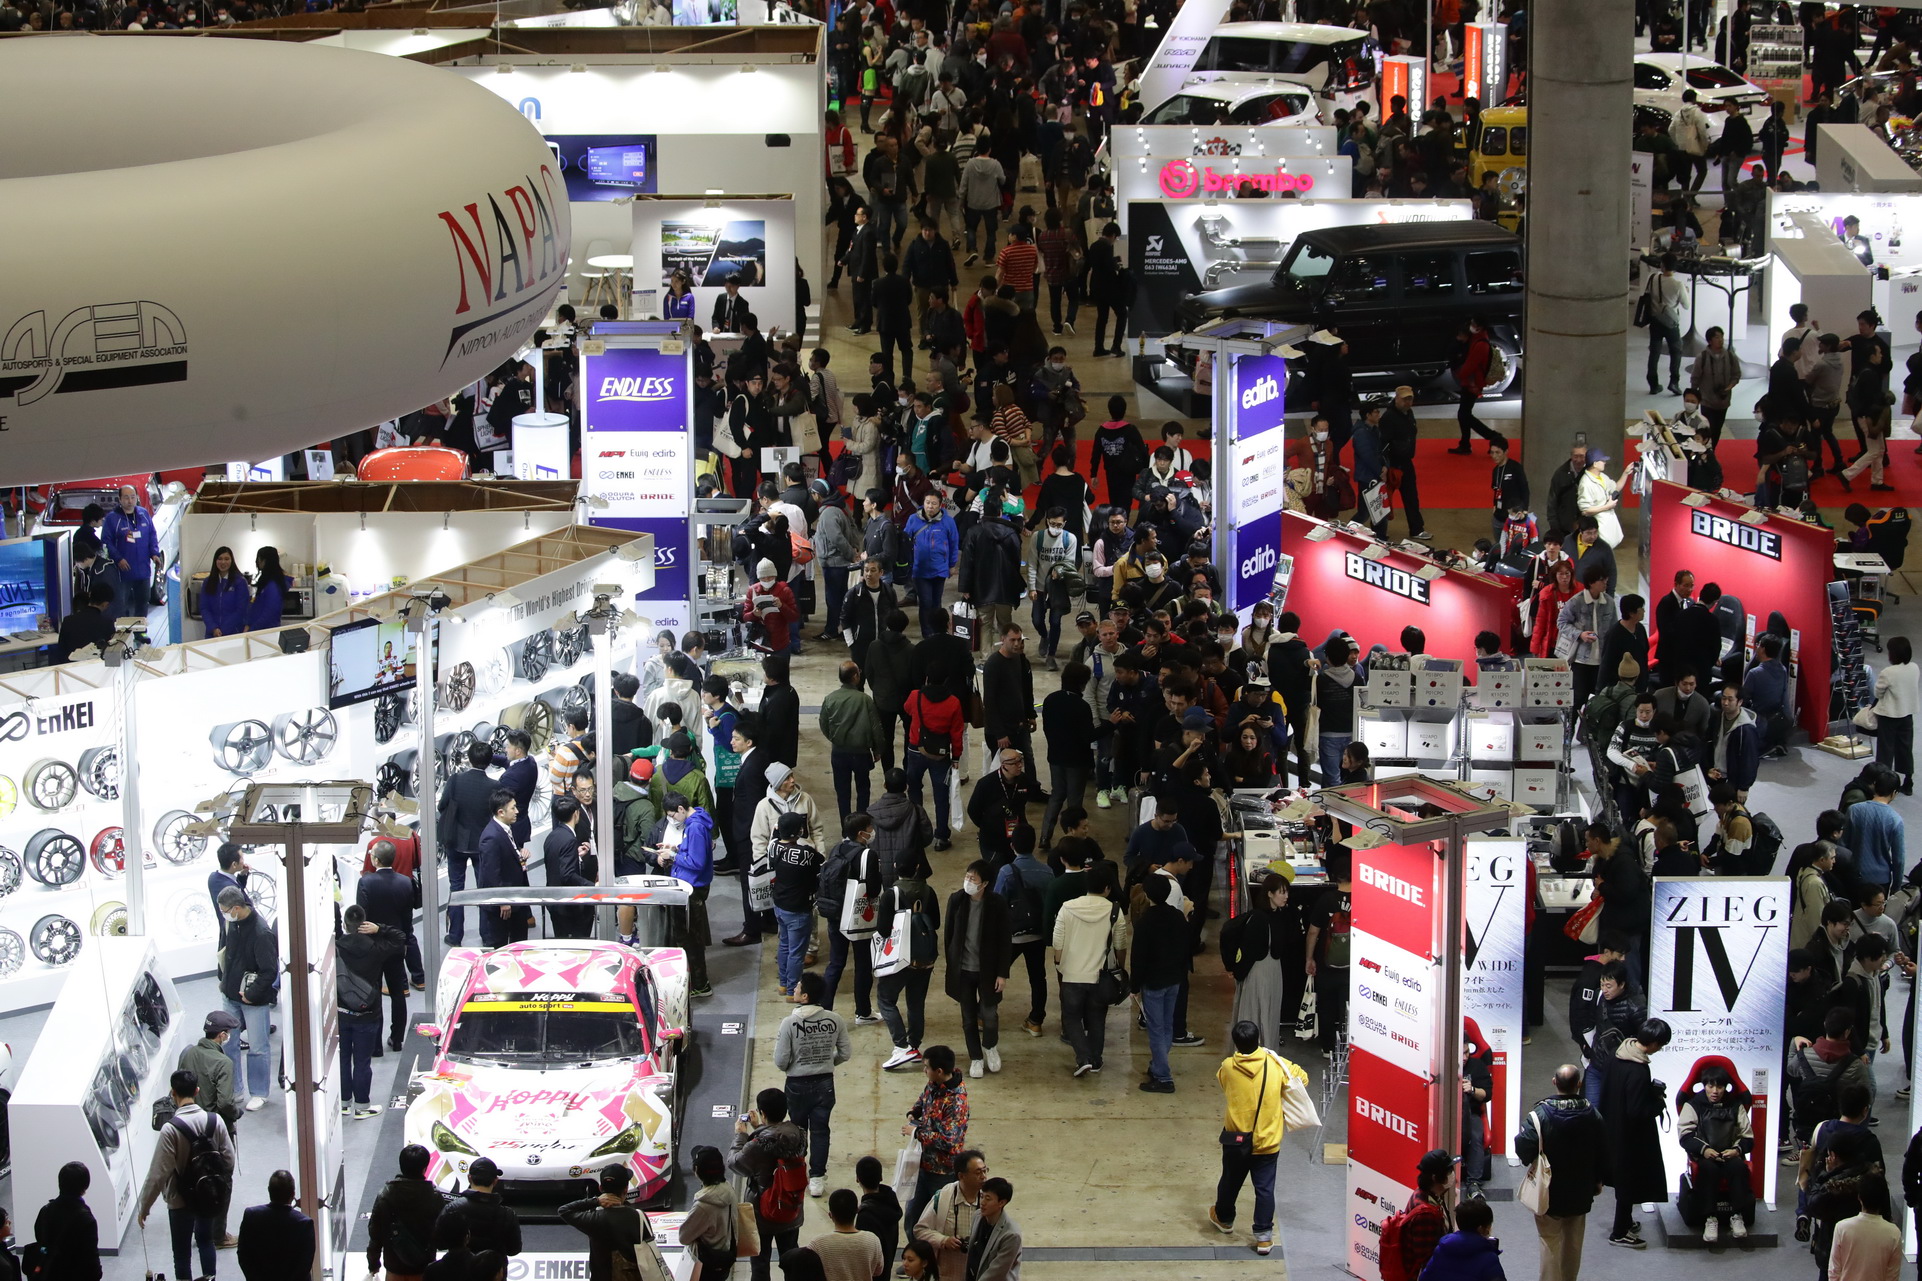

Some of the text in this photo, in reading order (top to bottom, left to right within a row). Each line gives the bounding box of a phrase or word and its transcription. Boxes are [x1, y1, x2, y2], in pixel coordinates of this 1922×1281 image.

[1203, 166, 1315, 192] brembo
[2, 346, 188, 371] AUTOSPORTS & SPECIAL EQUIPMENT ASSOCIATION
[599, 377, 675, 397] ENDLESS
[630, 448, 649, 458] Ewig
[652, 449, 676, 458] edirb
[525, 595, 551, 617] World's
[552, 585, 576, 610] Highest
[756, 892, 774, 902] LIGH
[1666, 895, 1778, 922] ZIEG
[1477, 960, 1518, 971] WIDE
[1662, 925, 1778, 1013] IV
[1384, 965, 1400, 984] Ewig
[1402, 977, 1422, 993] edirb
[538, 1003, 561, 1011] sport
[1394, 997, 1419, 1017] ENDLESS
[793, 1018, 837, 1038] Norton
[1364, 1015, 1387, 1031] OGURA
[1364, 1022, 1420, 1051] CLUTCH BRIDE
[1380, 1196, 1396, 1216] Ewig
[1368, 1220, 1382, 1237] ENKE
